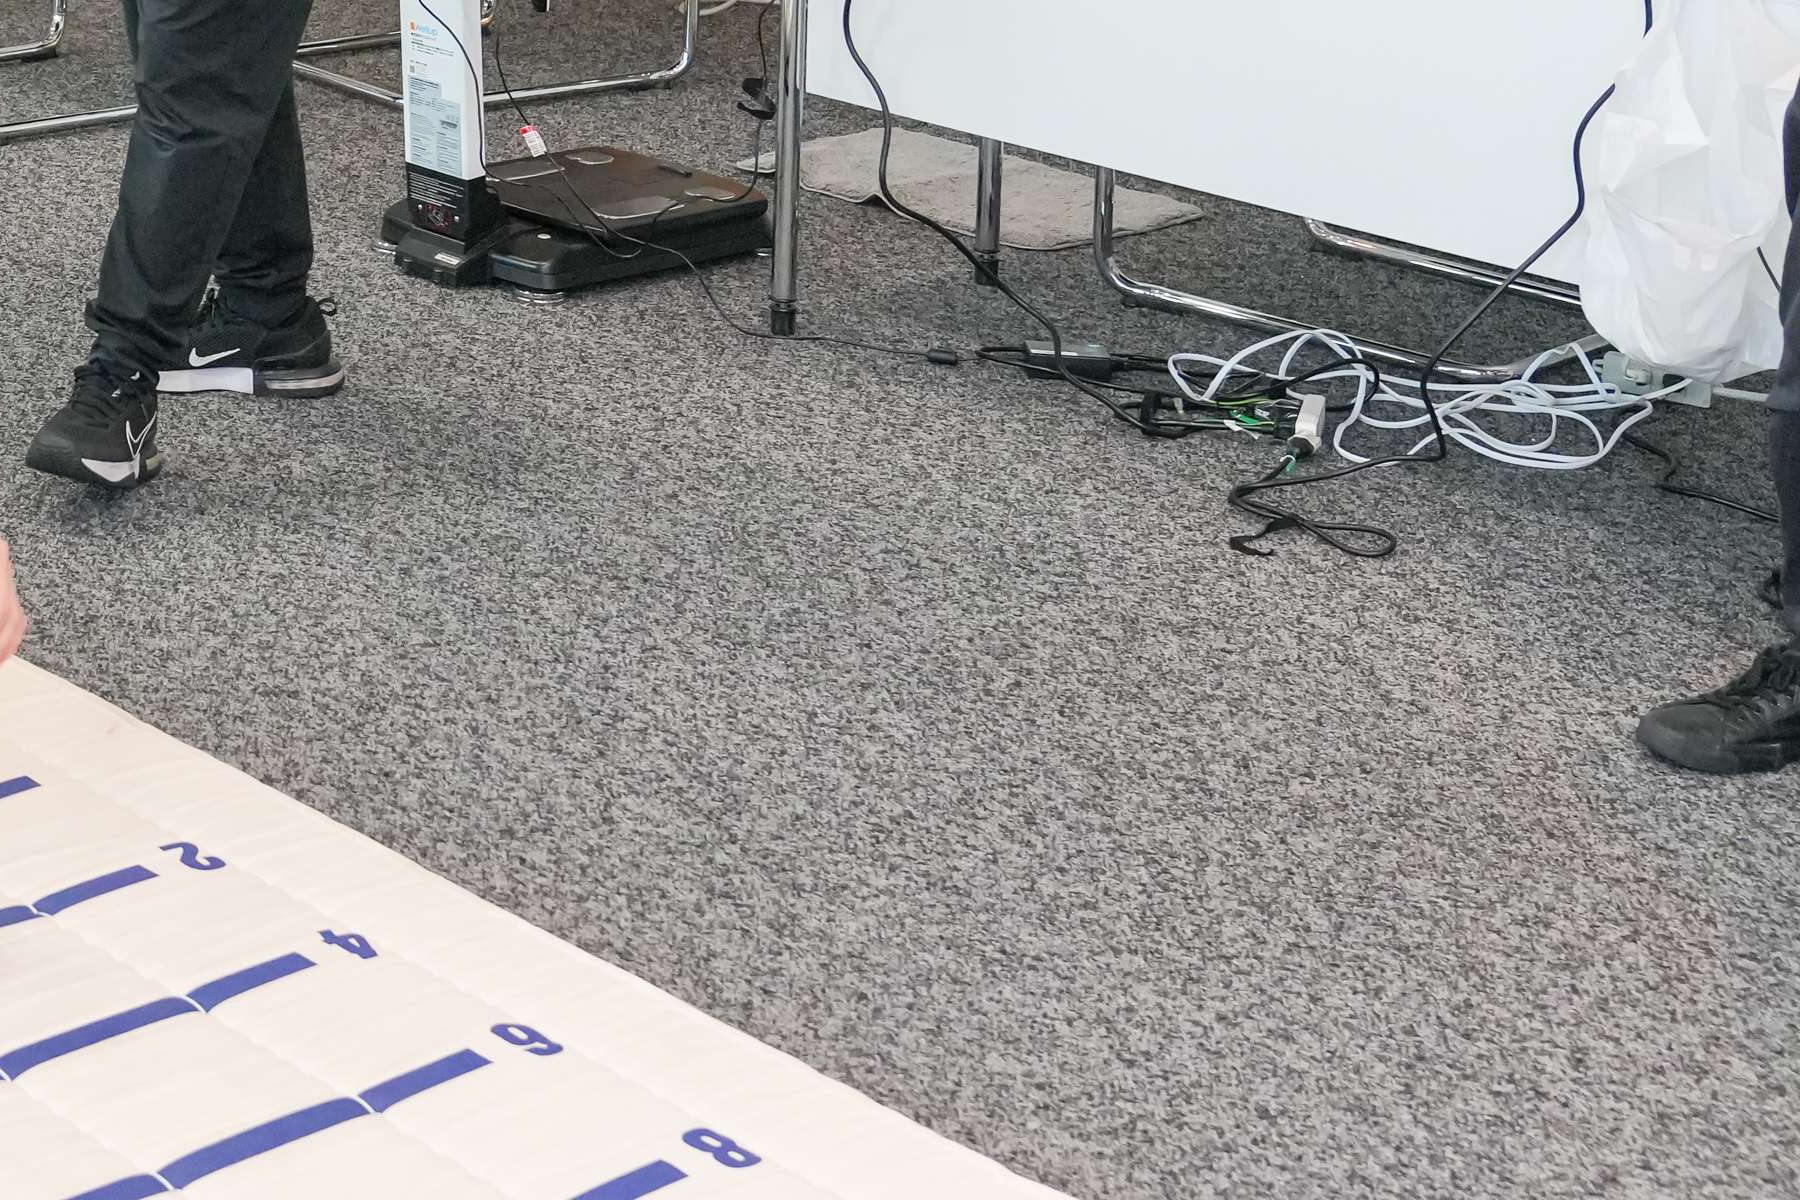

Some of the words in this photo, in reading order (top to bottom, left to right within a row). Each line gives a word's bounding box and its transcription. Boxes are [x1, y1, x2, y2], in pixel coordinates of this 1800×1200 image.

[157, 841, 227, 871] 2
[320, 929, 378, 960] 4
[492, 1023, 563, 1057] 6
[683, 1128, 762, 1168] 8
